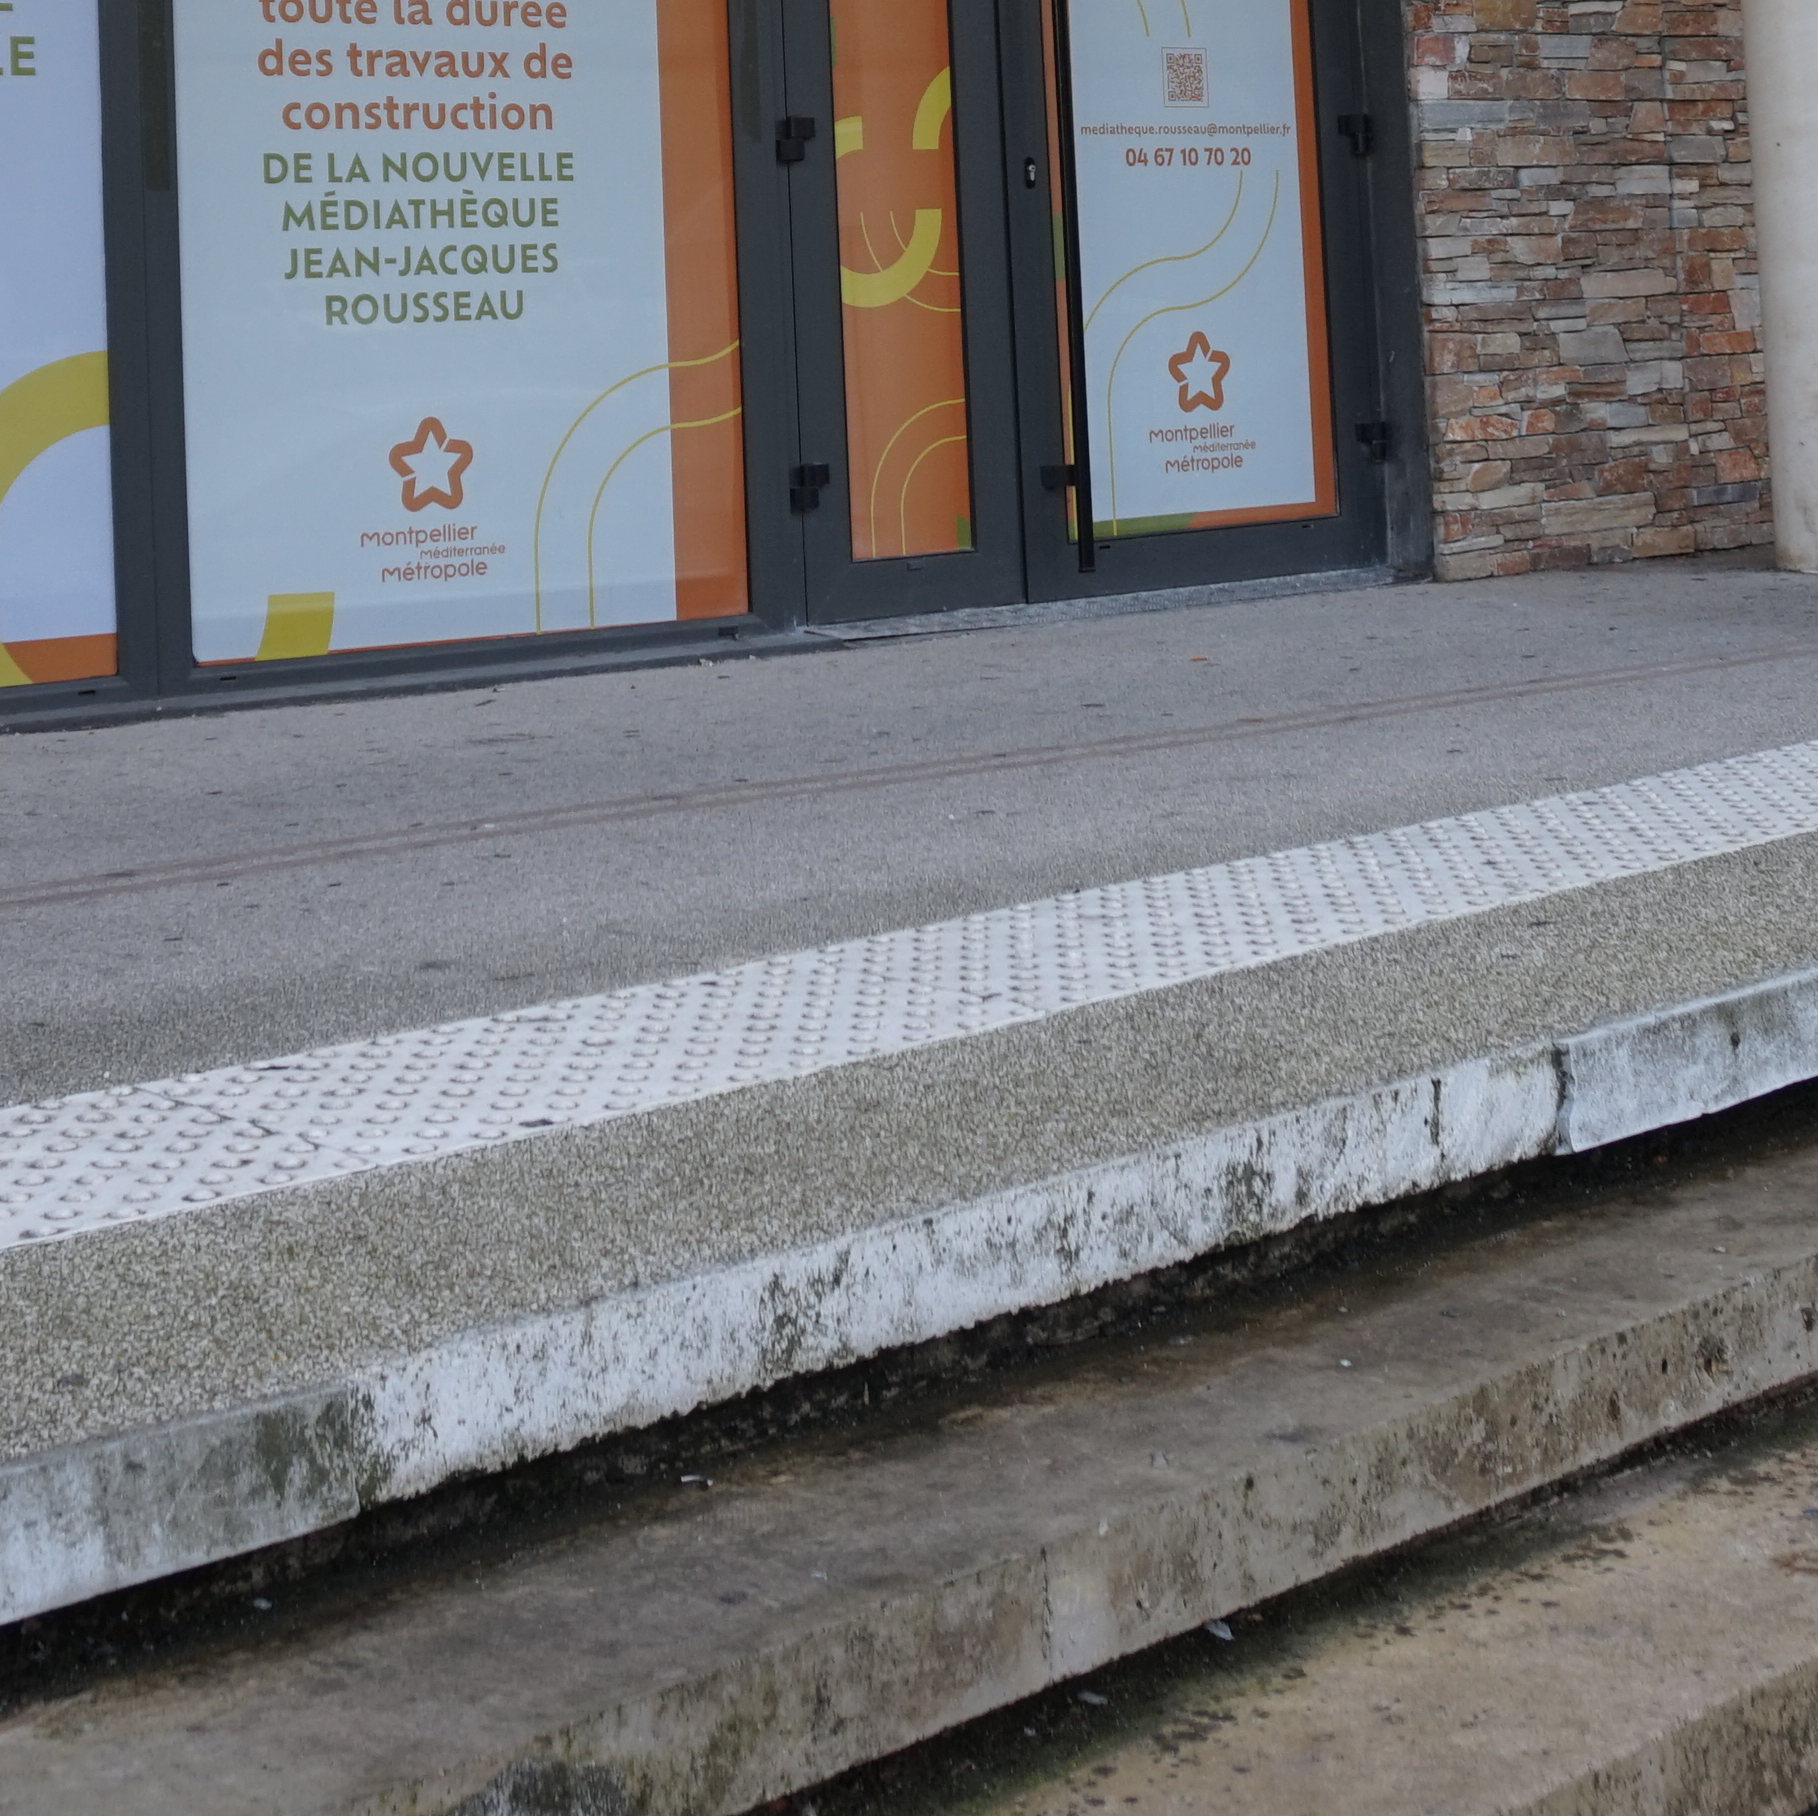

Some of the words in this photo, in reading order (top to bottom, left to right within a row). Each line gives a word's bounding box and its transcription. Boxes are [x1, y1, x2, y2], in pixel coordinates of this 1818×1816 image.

[257, 39, 334, 77] des
[347, 43, 511, 79] travaux
[523, 42, 574, 81] de
[281, 93, 554, 130] construction
[1081, 122, 1291, 137] mediatheque.rousseau@montpellier.fr
[262, 153, 313, 184] DE
[326, 152, 371, 183] LA
[383, 151, 575, 183] NOUVELLE
[1125, 147, 1149, 167] 04
[1154, 147, 1174, 167] 67
[1180, 147, 1199, 166] 10
[1203, 147, 1225, 166] 70
[1230, 147, 1252, 166] 20
[282, 190, 559, 232] MÉDIATHÈQUE
[284, 243, 559, 280] JEAN-JACQUES
[325, 290, 524, 327] ROUSSEAU
